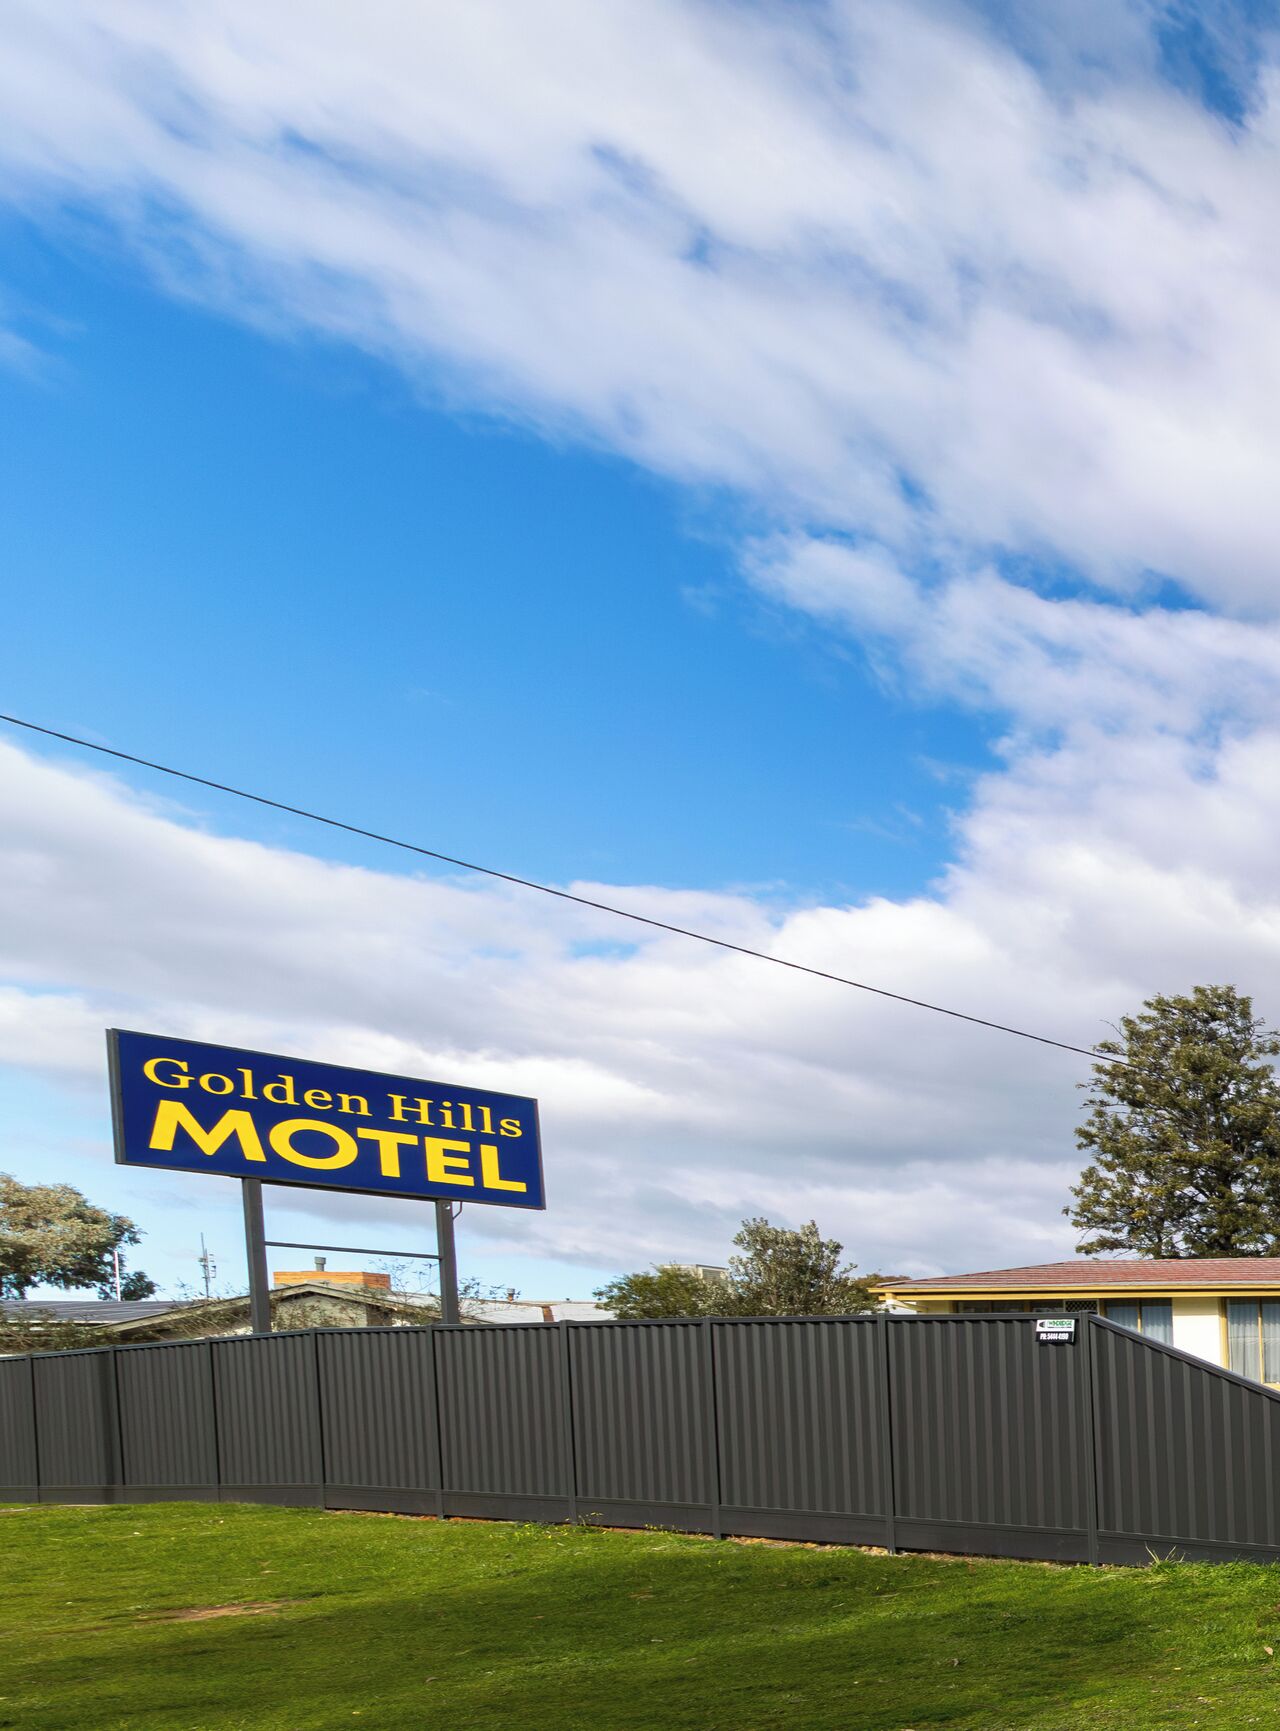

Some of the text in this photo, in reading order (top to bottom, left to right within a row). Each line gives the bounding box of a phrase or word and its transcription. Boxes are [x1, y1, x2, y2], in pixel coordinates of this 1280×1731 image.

[143, 1057, 523, 1138] Golden Hills
[148, 1099, 527, 1193] MOTEL
